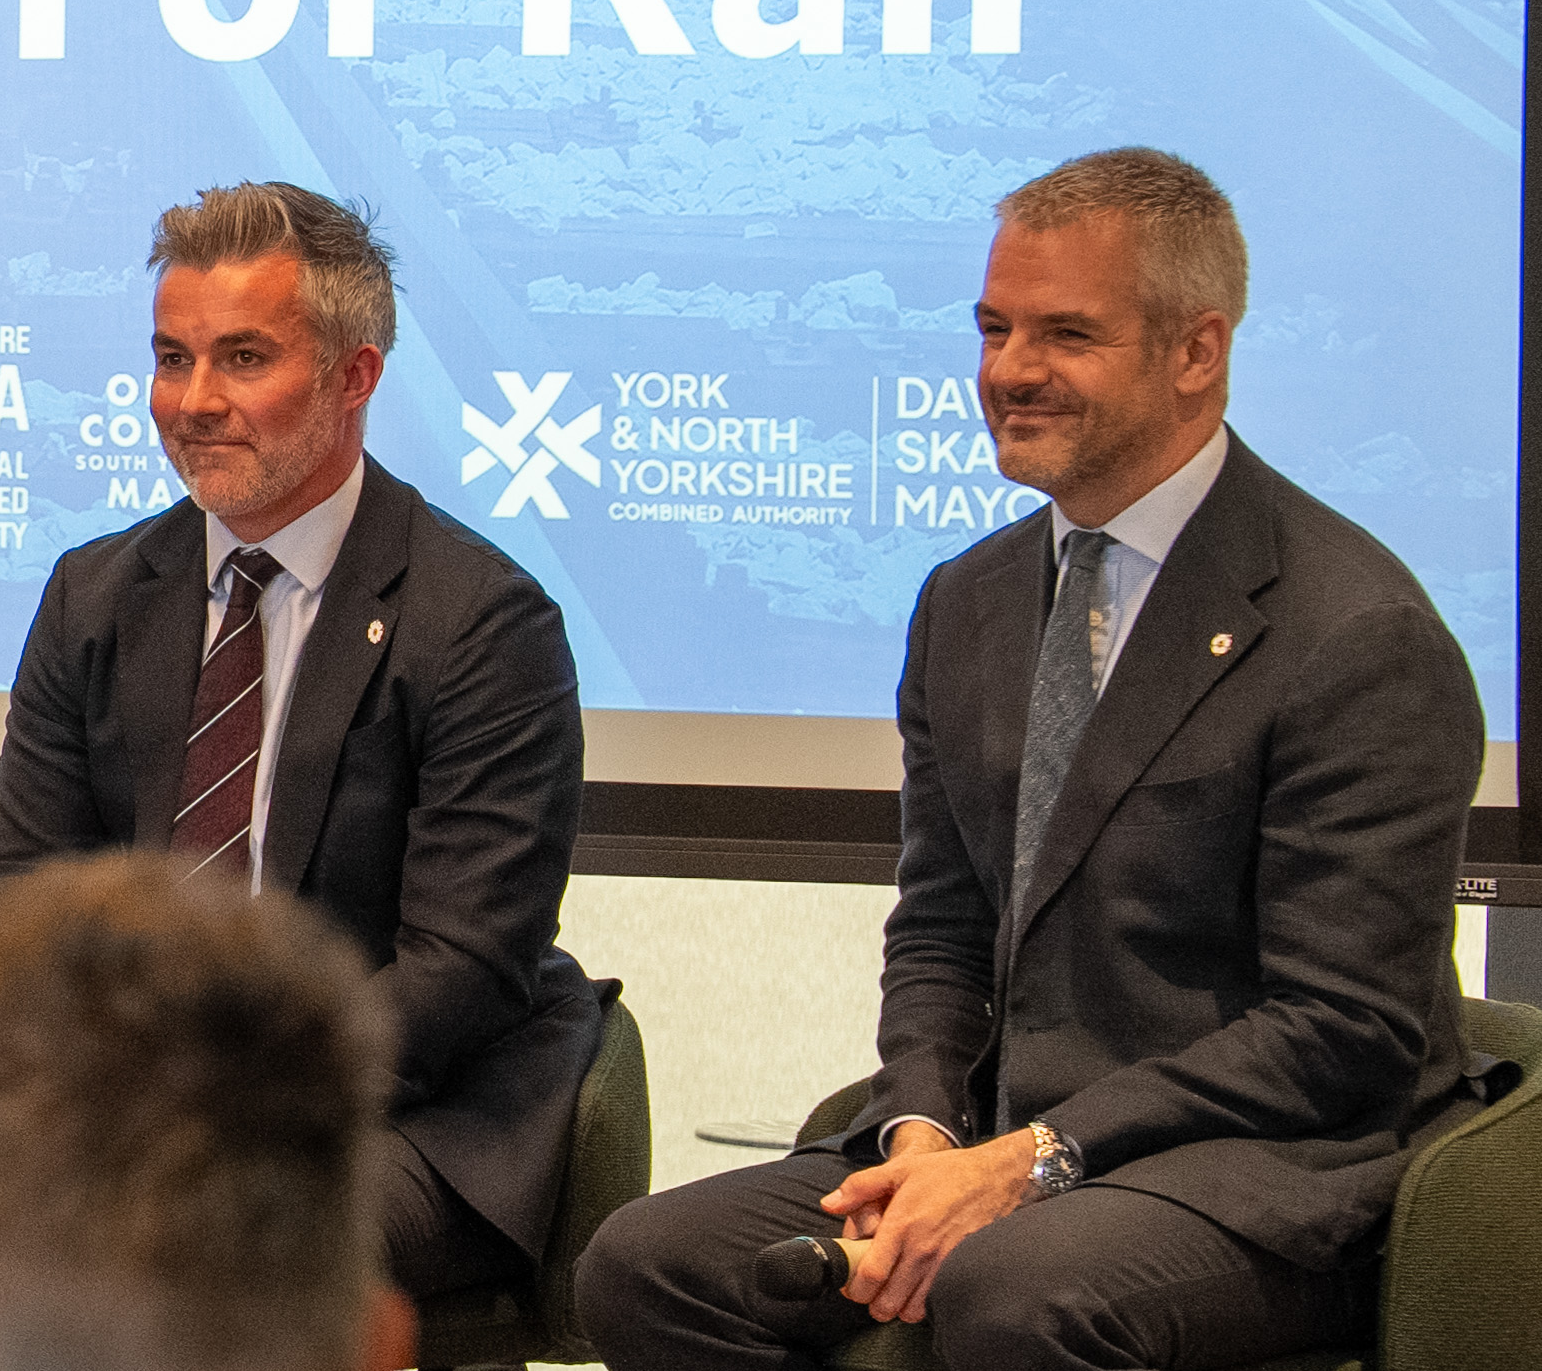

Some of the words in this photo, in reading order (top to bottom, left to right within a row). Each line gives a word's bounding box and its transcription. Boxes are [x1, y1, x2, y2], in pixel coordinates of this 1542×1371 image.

[612, 372, 729, 409] YORK
[611, 415, 639, 451] &
[650, 416, 797, 453] NORTH
[895, 430, 1000, 474] SKA
[75, 454, 148, 471] SOUTH
[610, 459, 853, 499] YORKSHIRE
[608, 502, 724, 523] COMBINED
[732, 505, 852, 525] AUTHORITY
[895, 485, 1052, 528] MAYO
